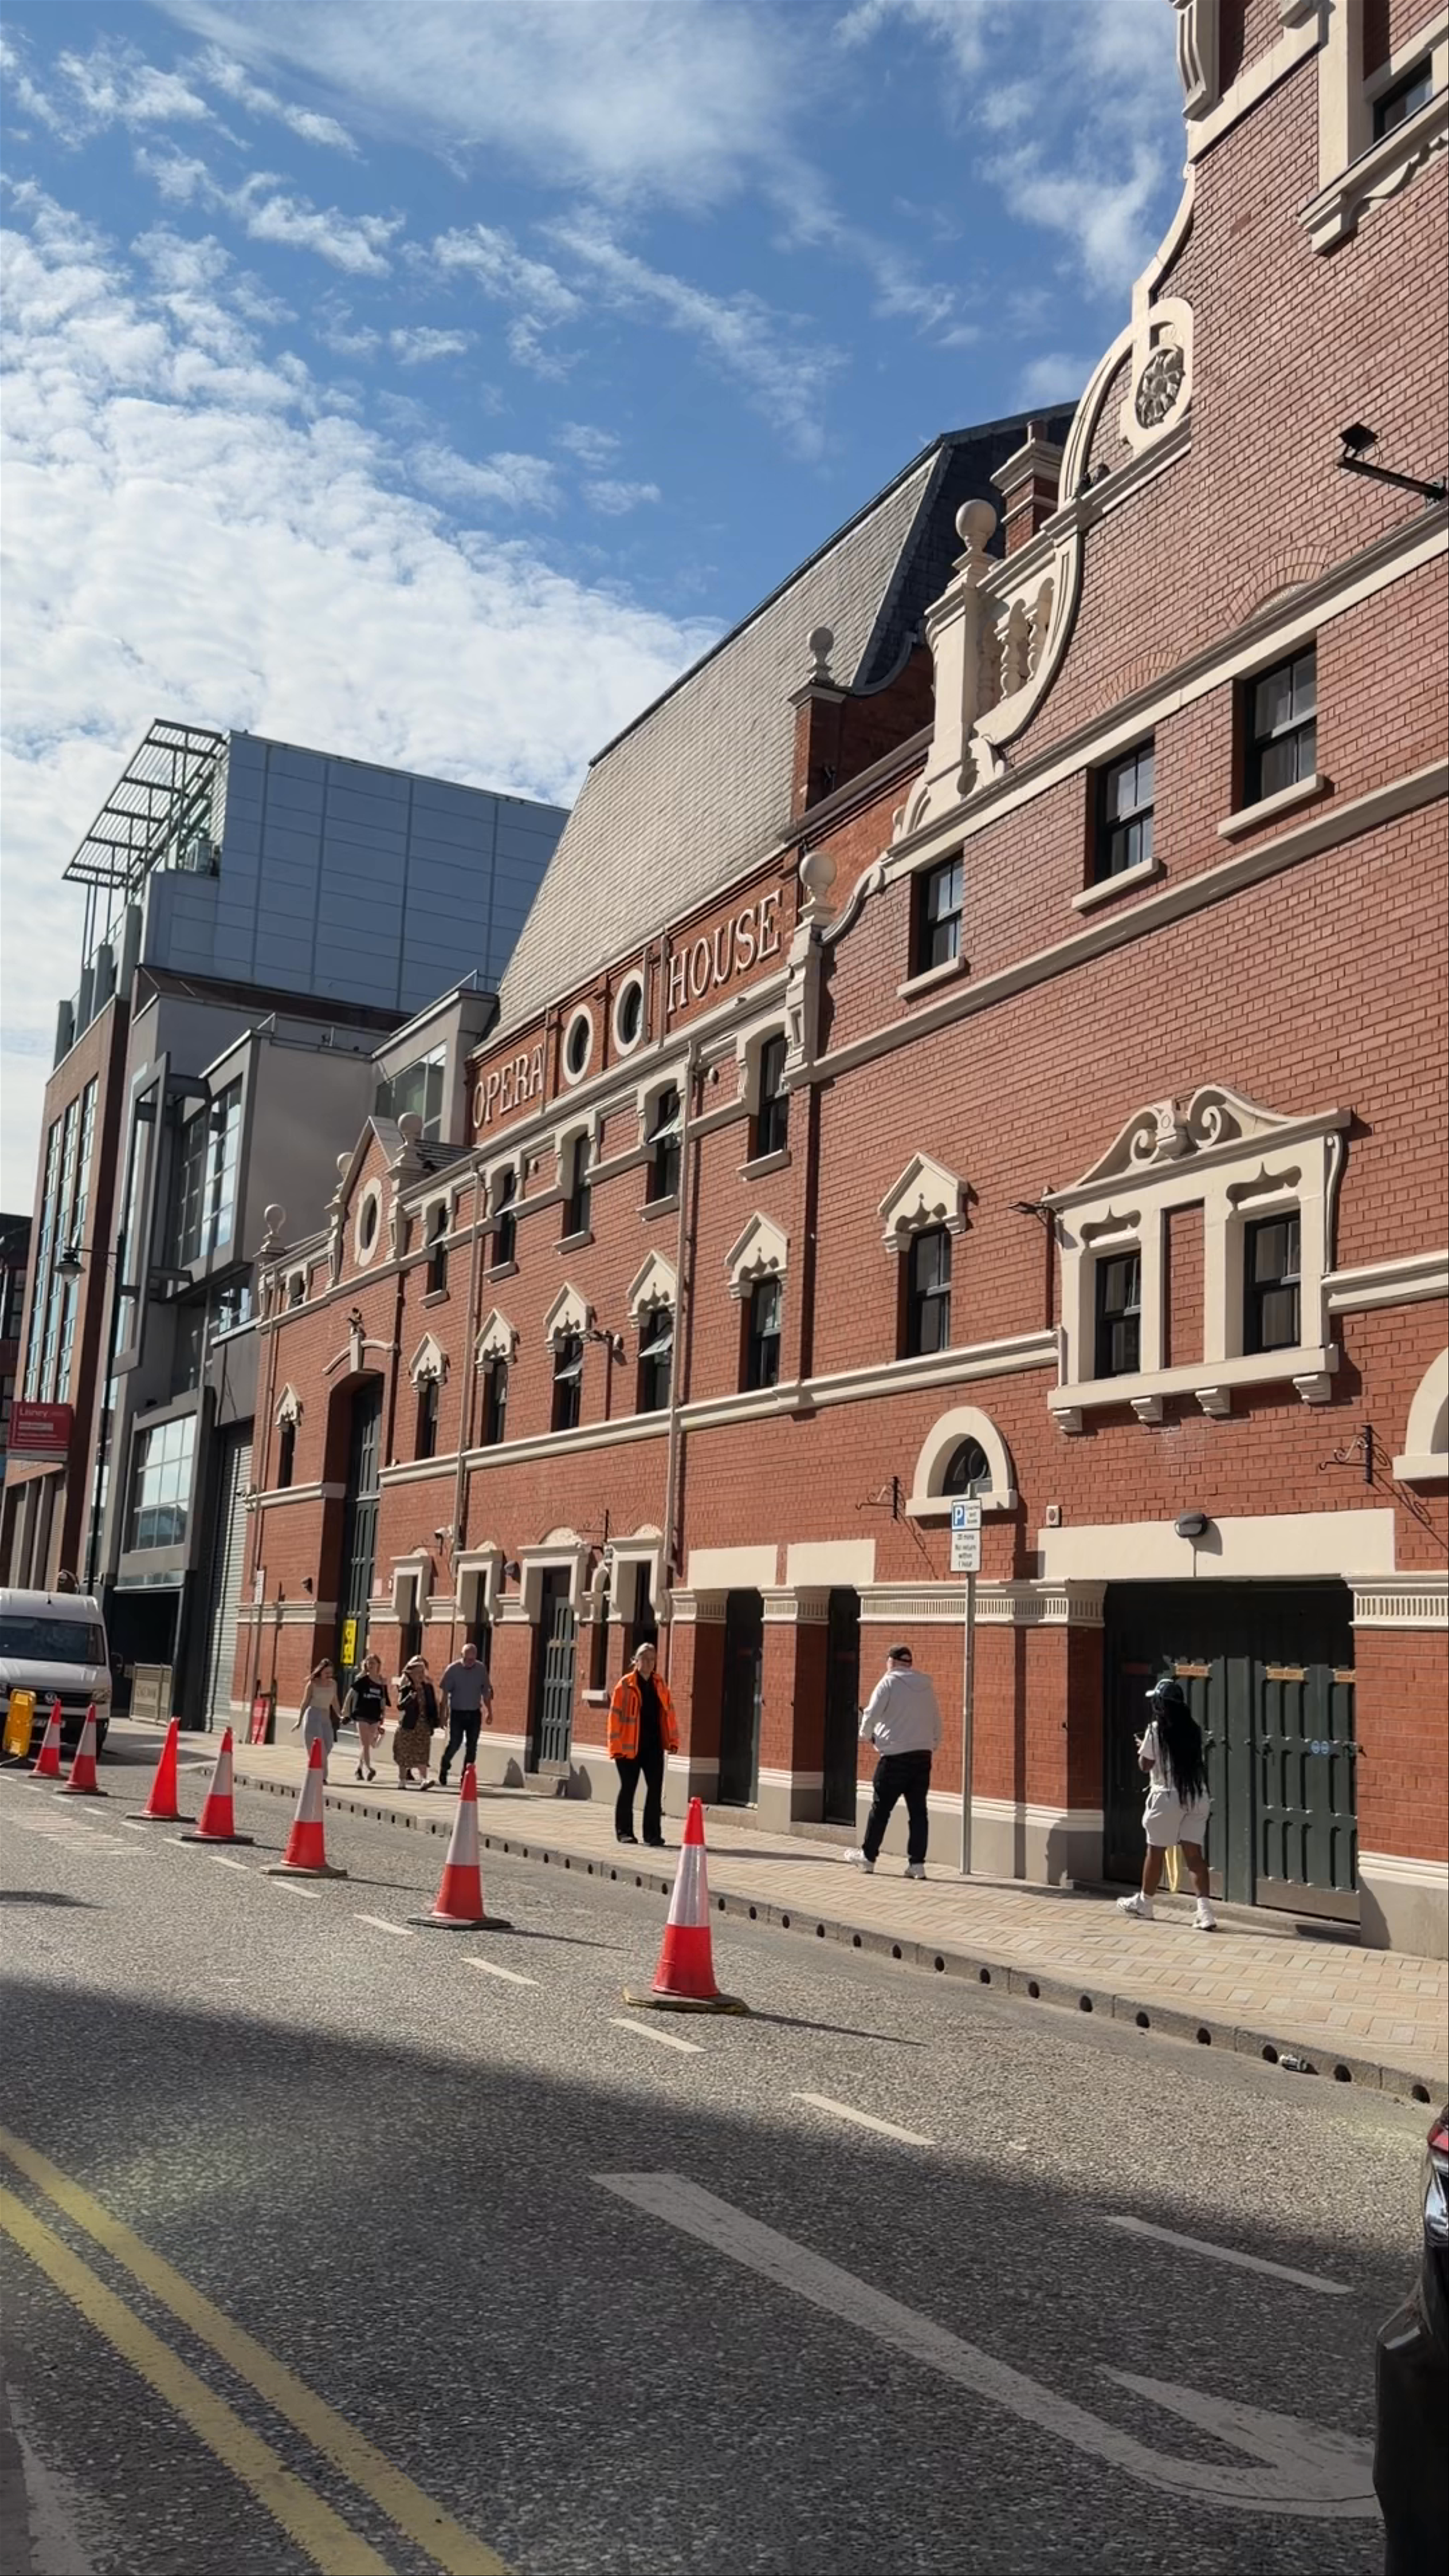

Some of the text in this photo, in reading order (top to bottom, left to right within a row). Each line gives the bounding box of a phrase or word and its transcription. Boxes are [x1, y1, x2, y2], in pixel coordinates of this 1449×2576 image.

[473, 889, 781, 1128] OPERA HOUSE
[954, 1507, 963, 1525] P
